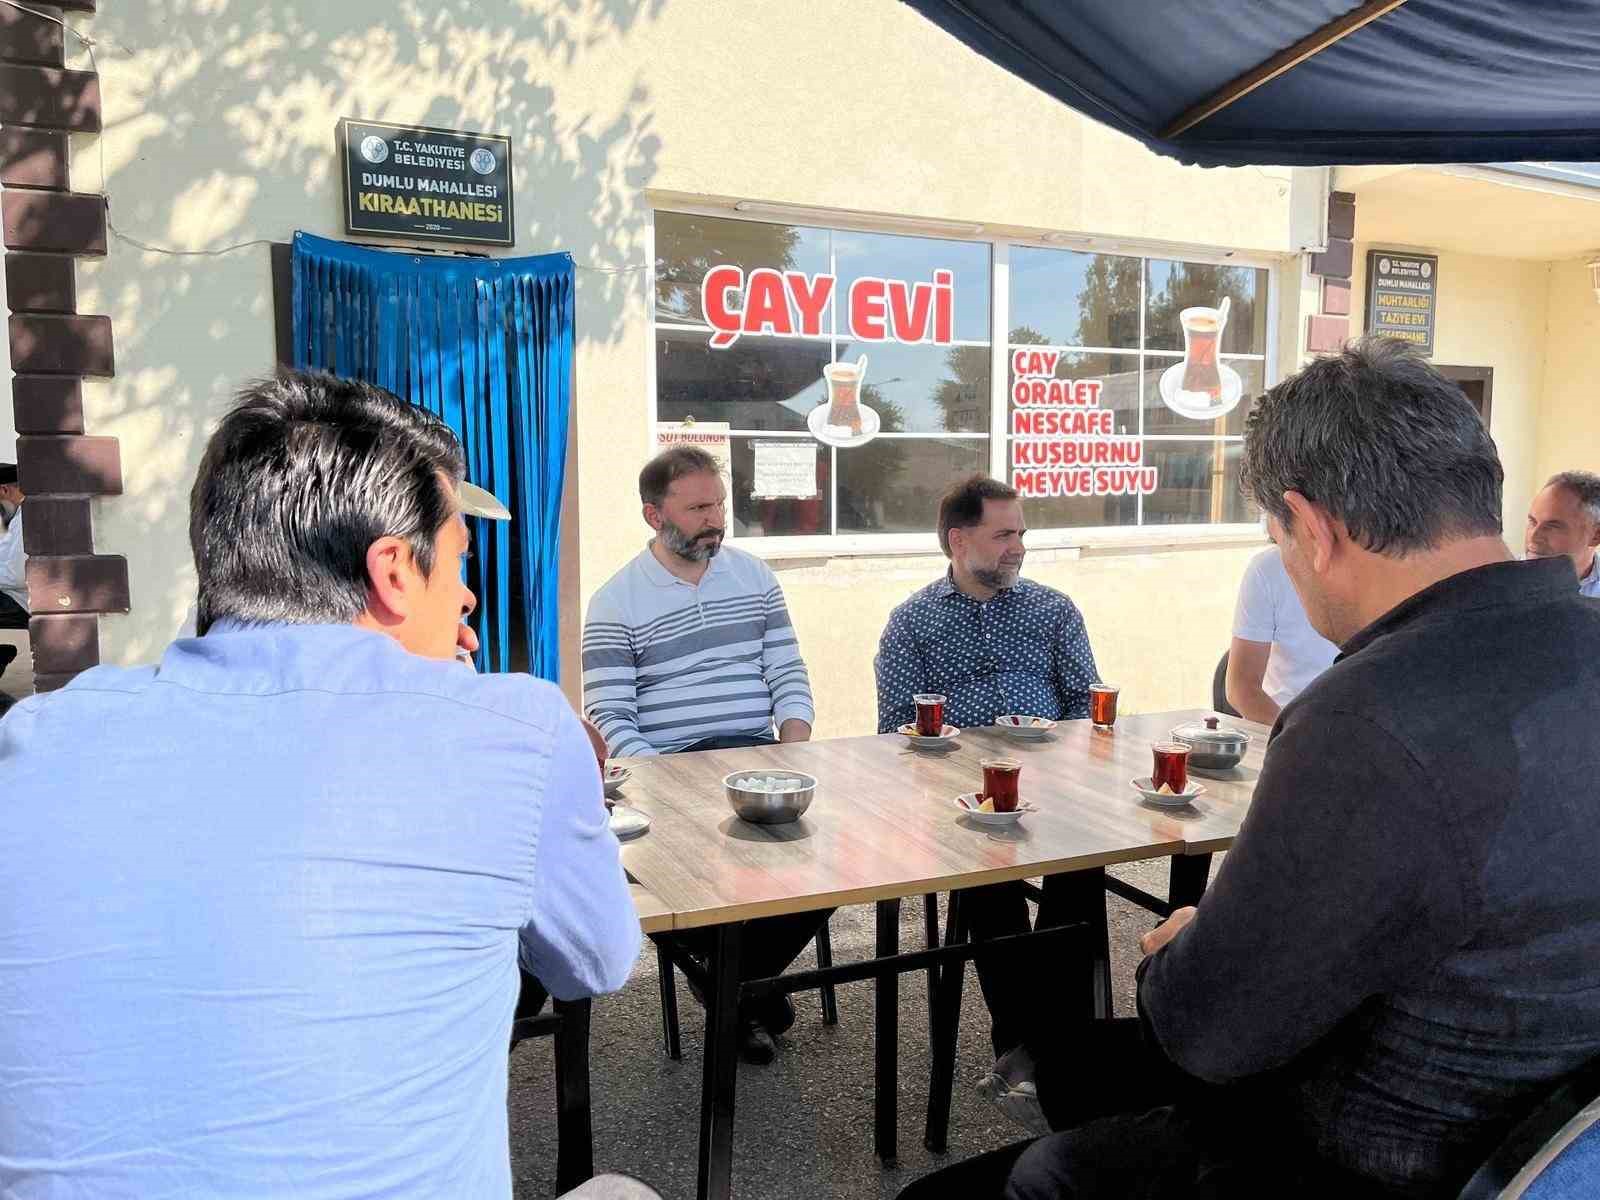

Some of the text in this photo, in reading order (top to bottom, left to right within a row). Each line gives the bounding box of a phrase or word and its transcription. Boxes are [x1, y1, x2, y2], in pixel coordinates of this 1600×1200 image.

[394, 140, 465, 158] T.C. YAKUTİYE
[394, 153, 465, 171] BELEDİYESİ
[362, 173, 497, 198] DUMLU MAHALLESİ
[359, 192, 503, 223] KIRAATHANESİ
[703, 265, 953, 348] ÇAY EVİ
[1013, 380, 1102, 406] ORALET
[1014, 411, 1114, 436] NESCAFE
[1014, 469, 1157, 496] MEYVE SUYU
